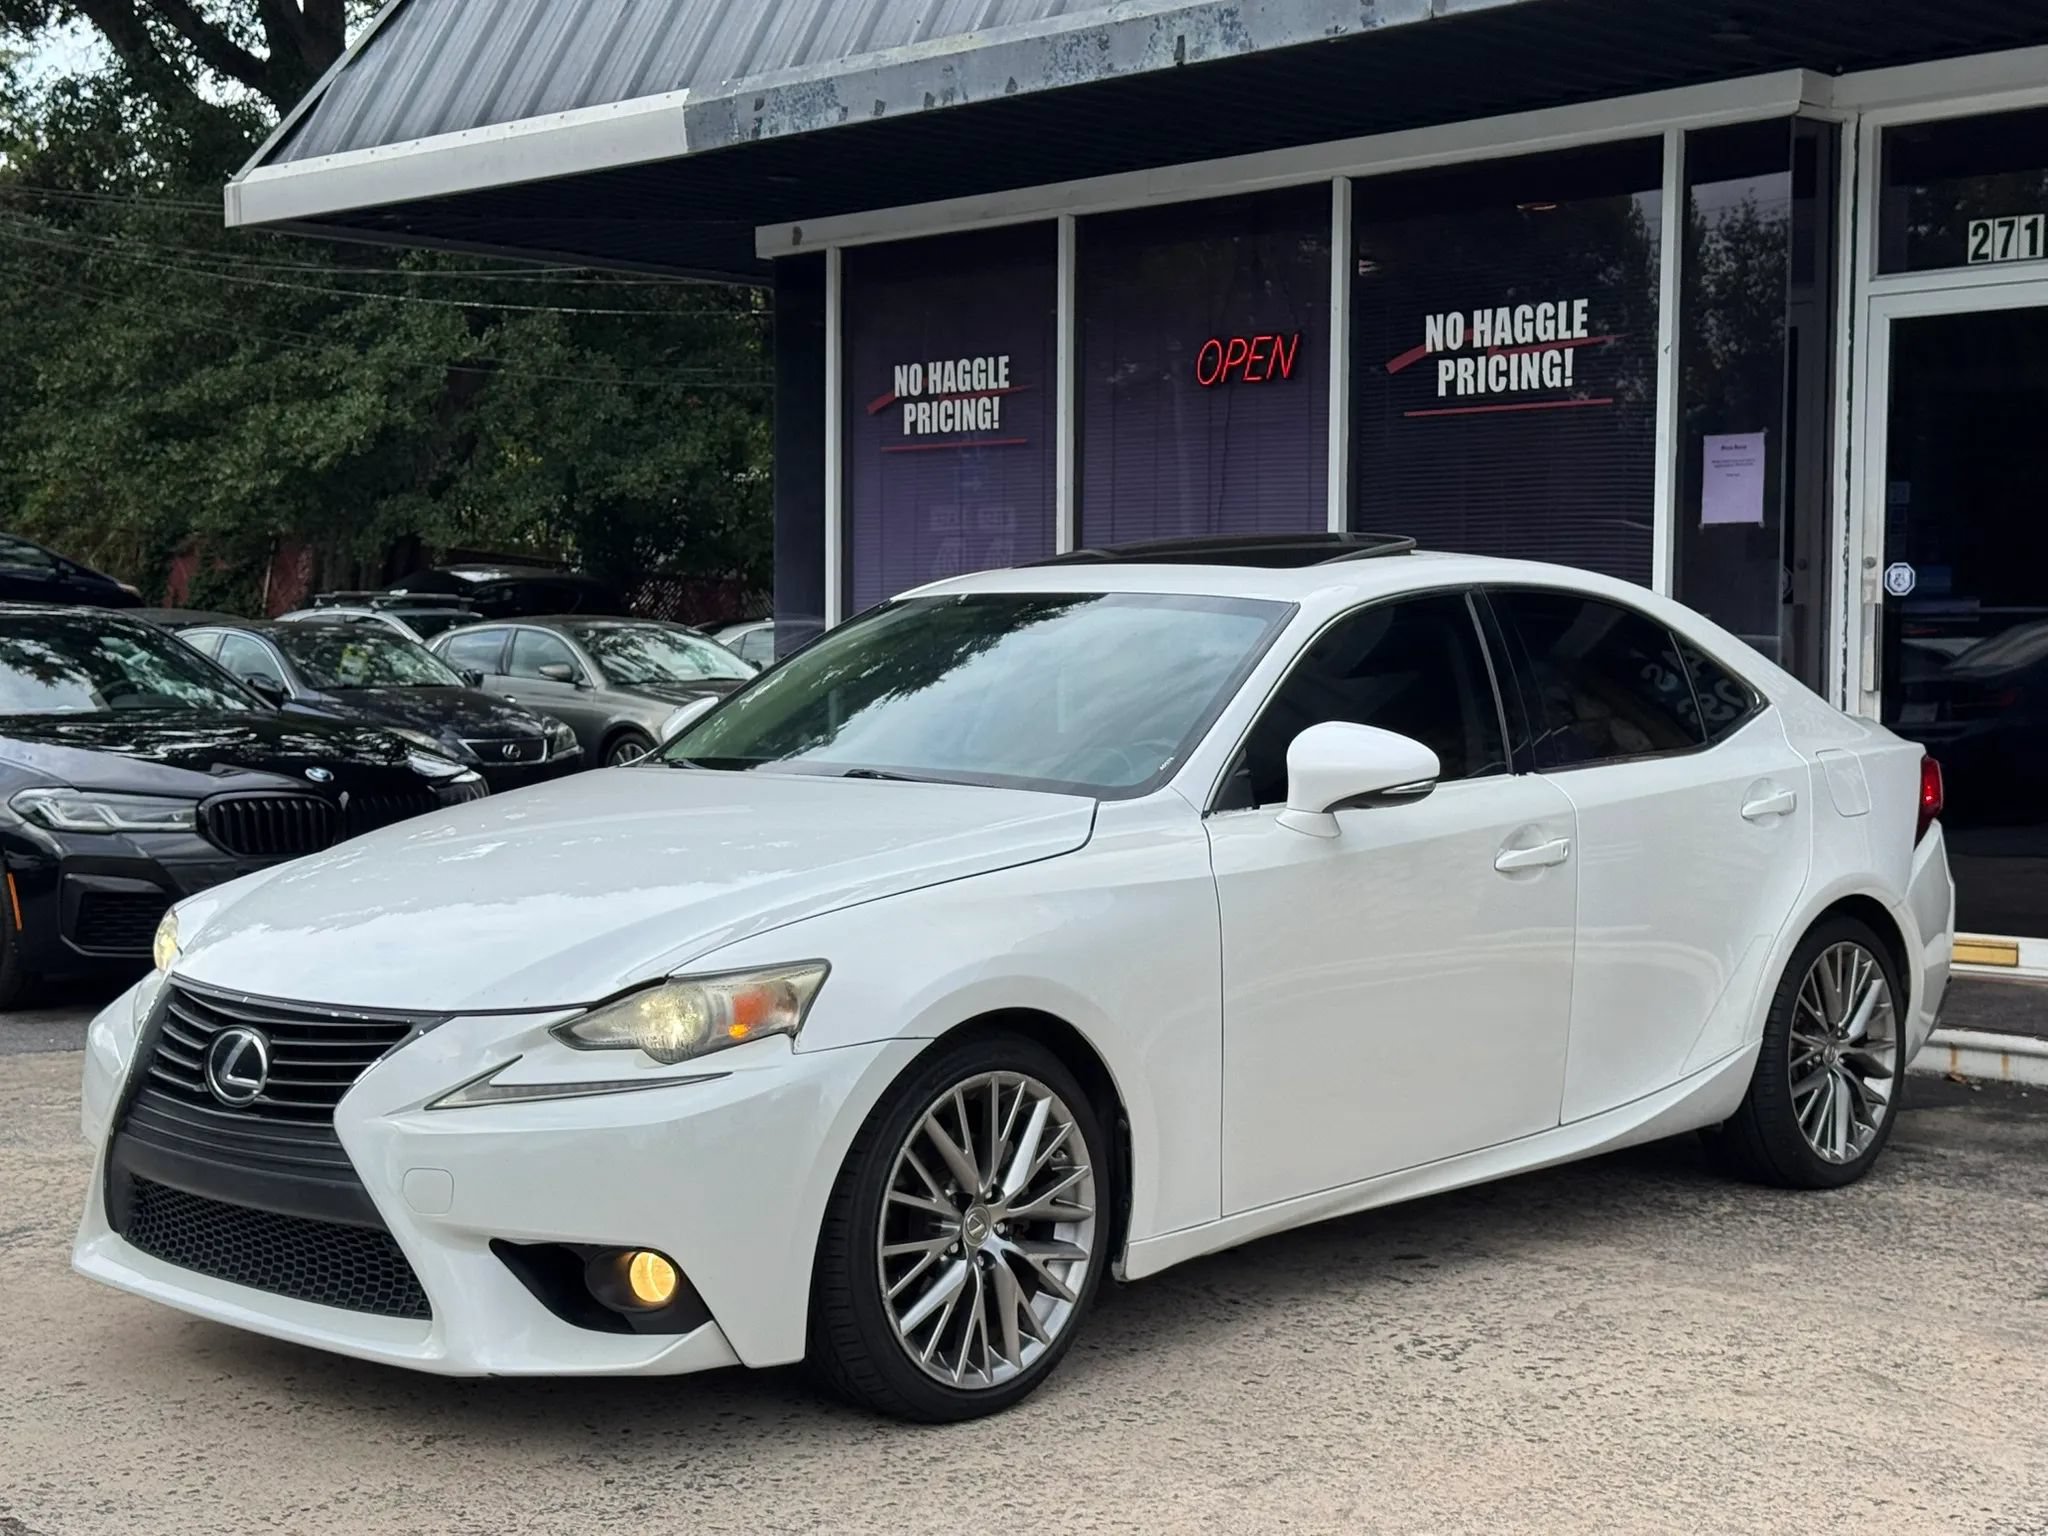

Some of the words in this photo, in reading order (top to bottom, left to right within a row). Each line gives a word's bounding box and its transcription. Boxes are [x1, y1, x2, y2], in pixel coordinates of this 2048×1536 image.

[1970, 217, 2039, 261] 271
[1425, 311, 1465, 352] NO
[1472, 298, 1589, 348] HAGGLE
[894, 363, 923, 398] NO
[927, 355, 1010, 395] HAGGLE
[1196, 333, 1299, 386] OPEN
[1437, 347, 1574, 397] PRICING!
[903, 396, 1000, 435] PRICING!
